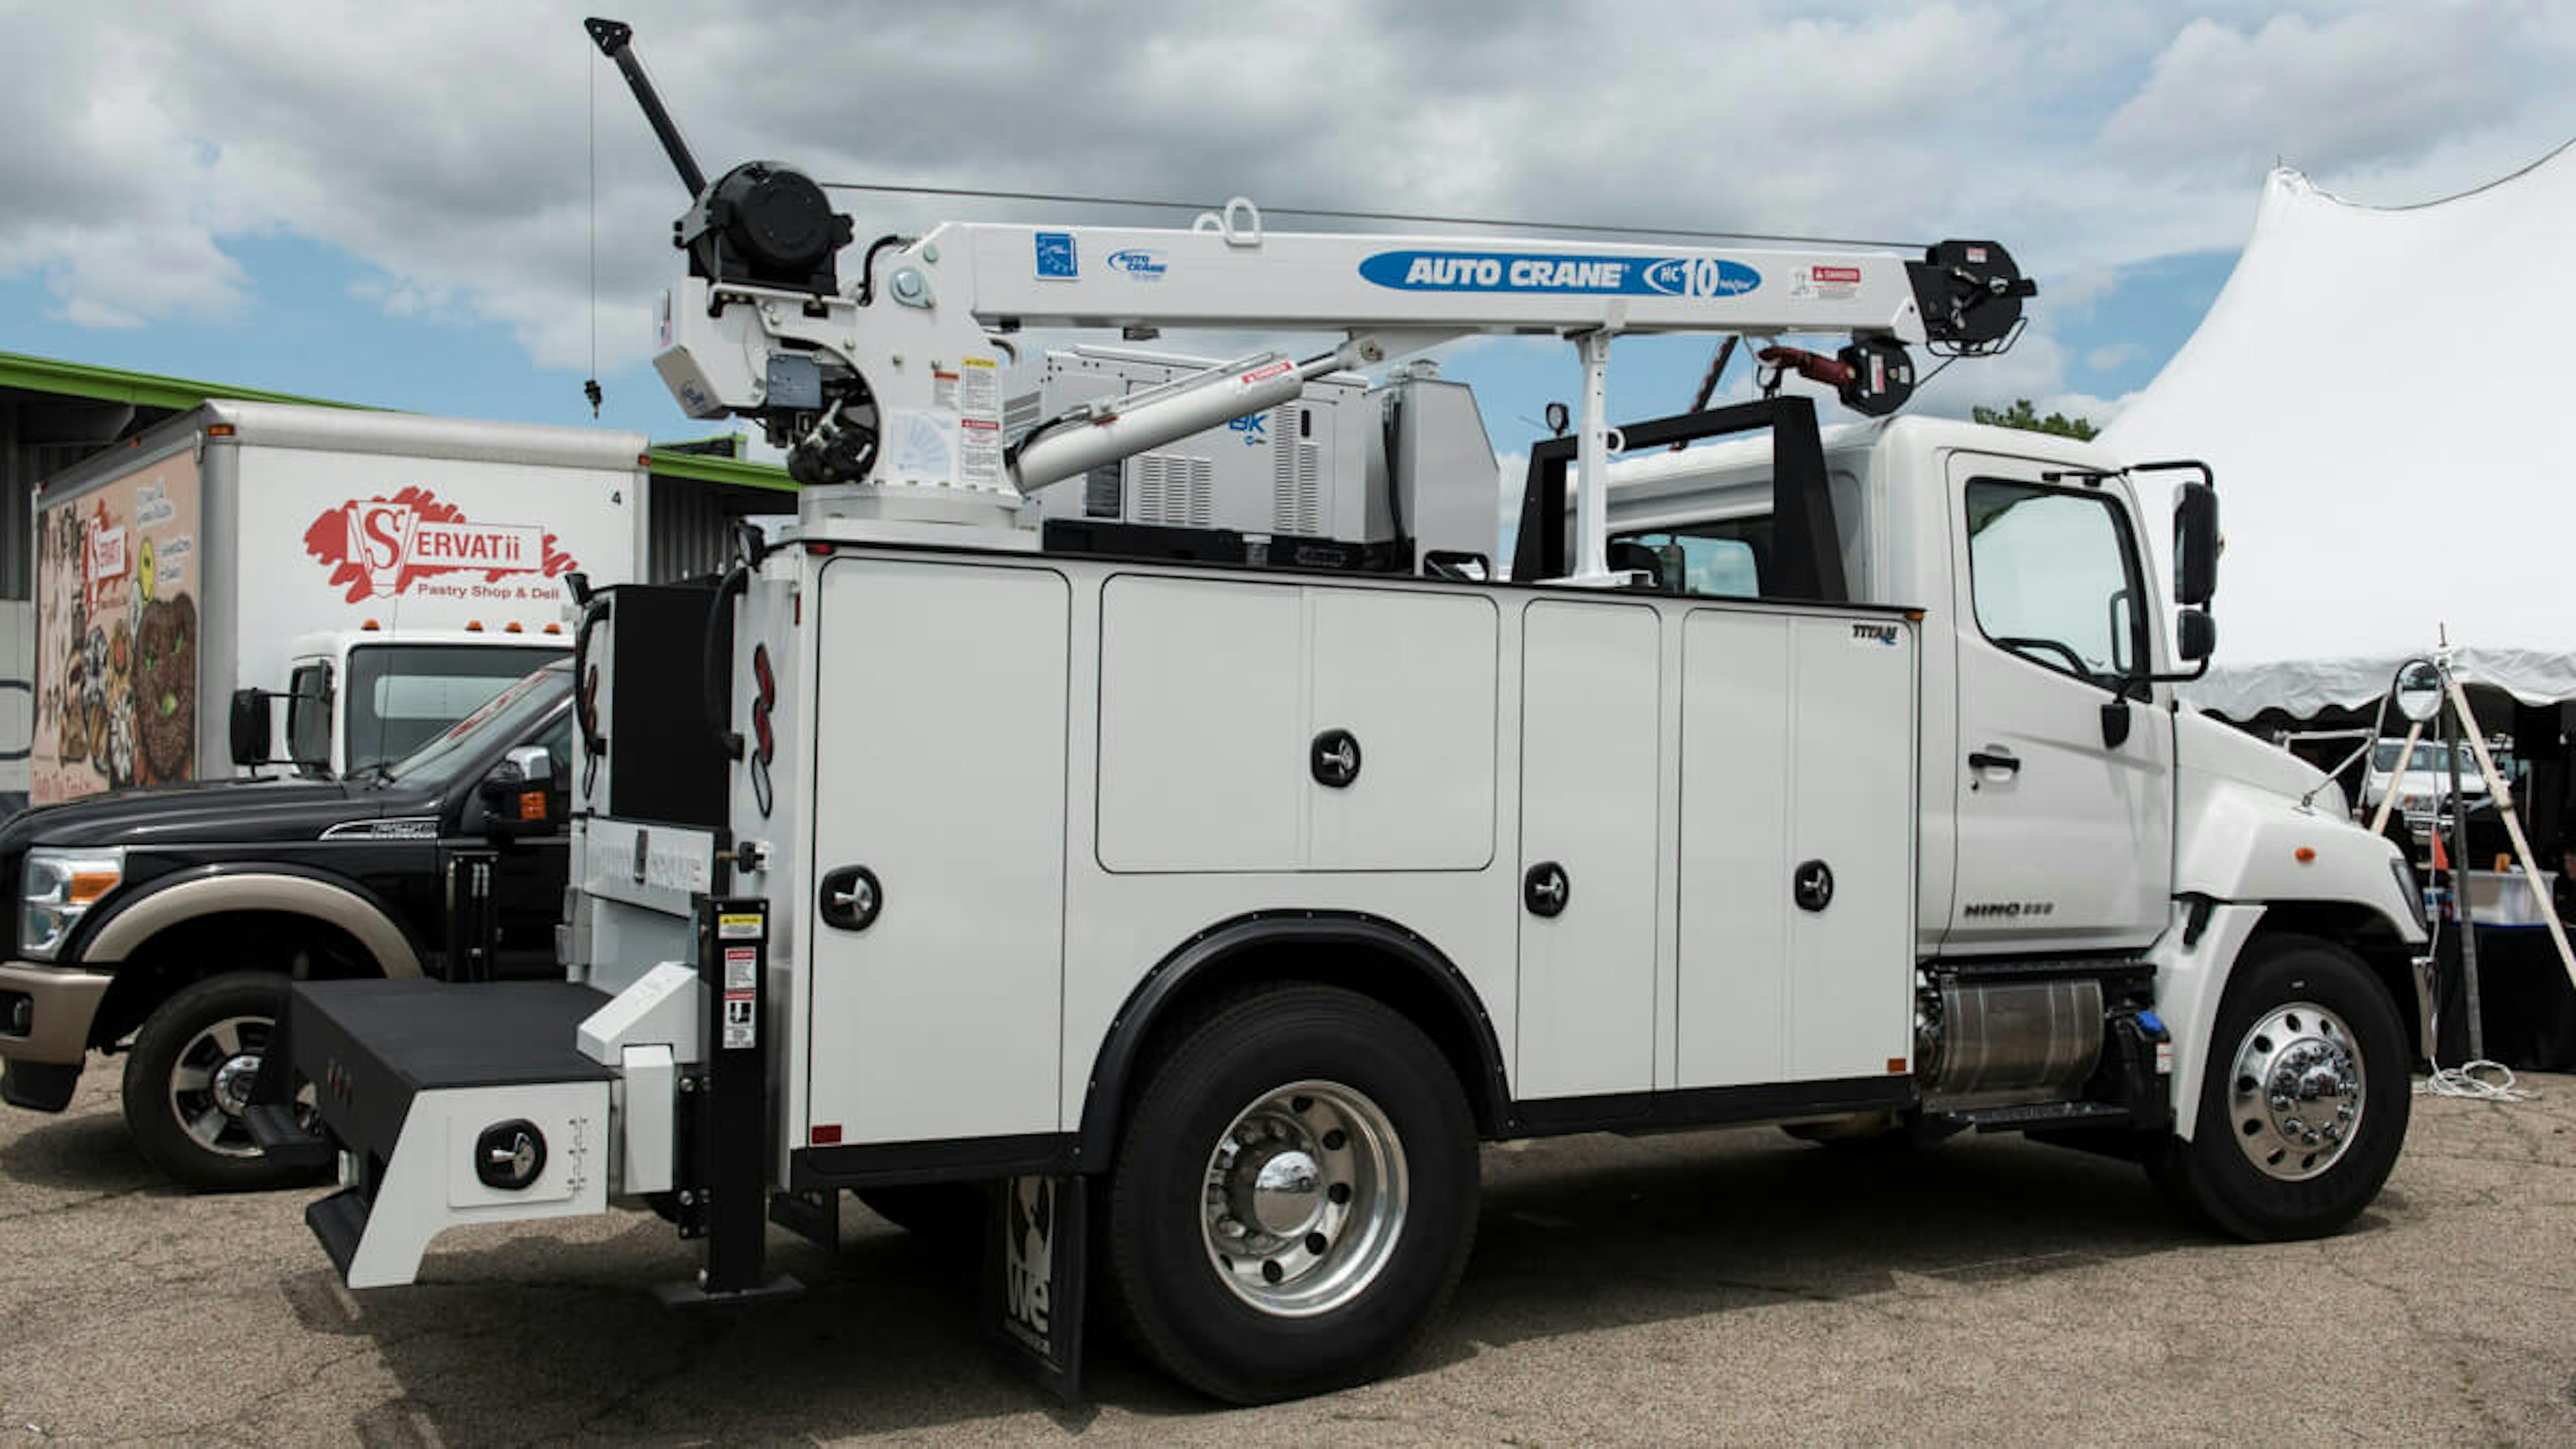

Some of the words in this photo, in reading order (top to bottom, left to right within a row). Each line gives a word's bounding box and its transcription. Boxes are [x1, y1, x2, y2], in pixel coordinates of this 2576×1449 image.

[1405, 257, 1502, 285] AUTO
[1509, 260, 1622, 288] CRANE
[1661, 266, 1680, 283] HC
[1681, 258, 1719, 297] 10
[611, 491, 621, 506] 4
[418, 584, 468, 598] Pastry
[472, 586, 512, 599] Shop
[516, 588, 527, 598] &
[532, 588, 559, 600] Deli
